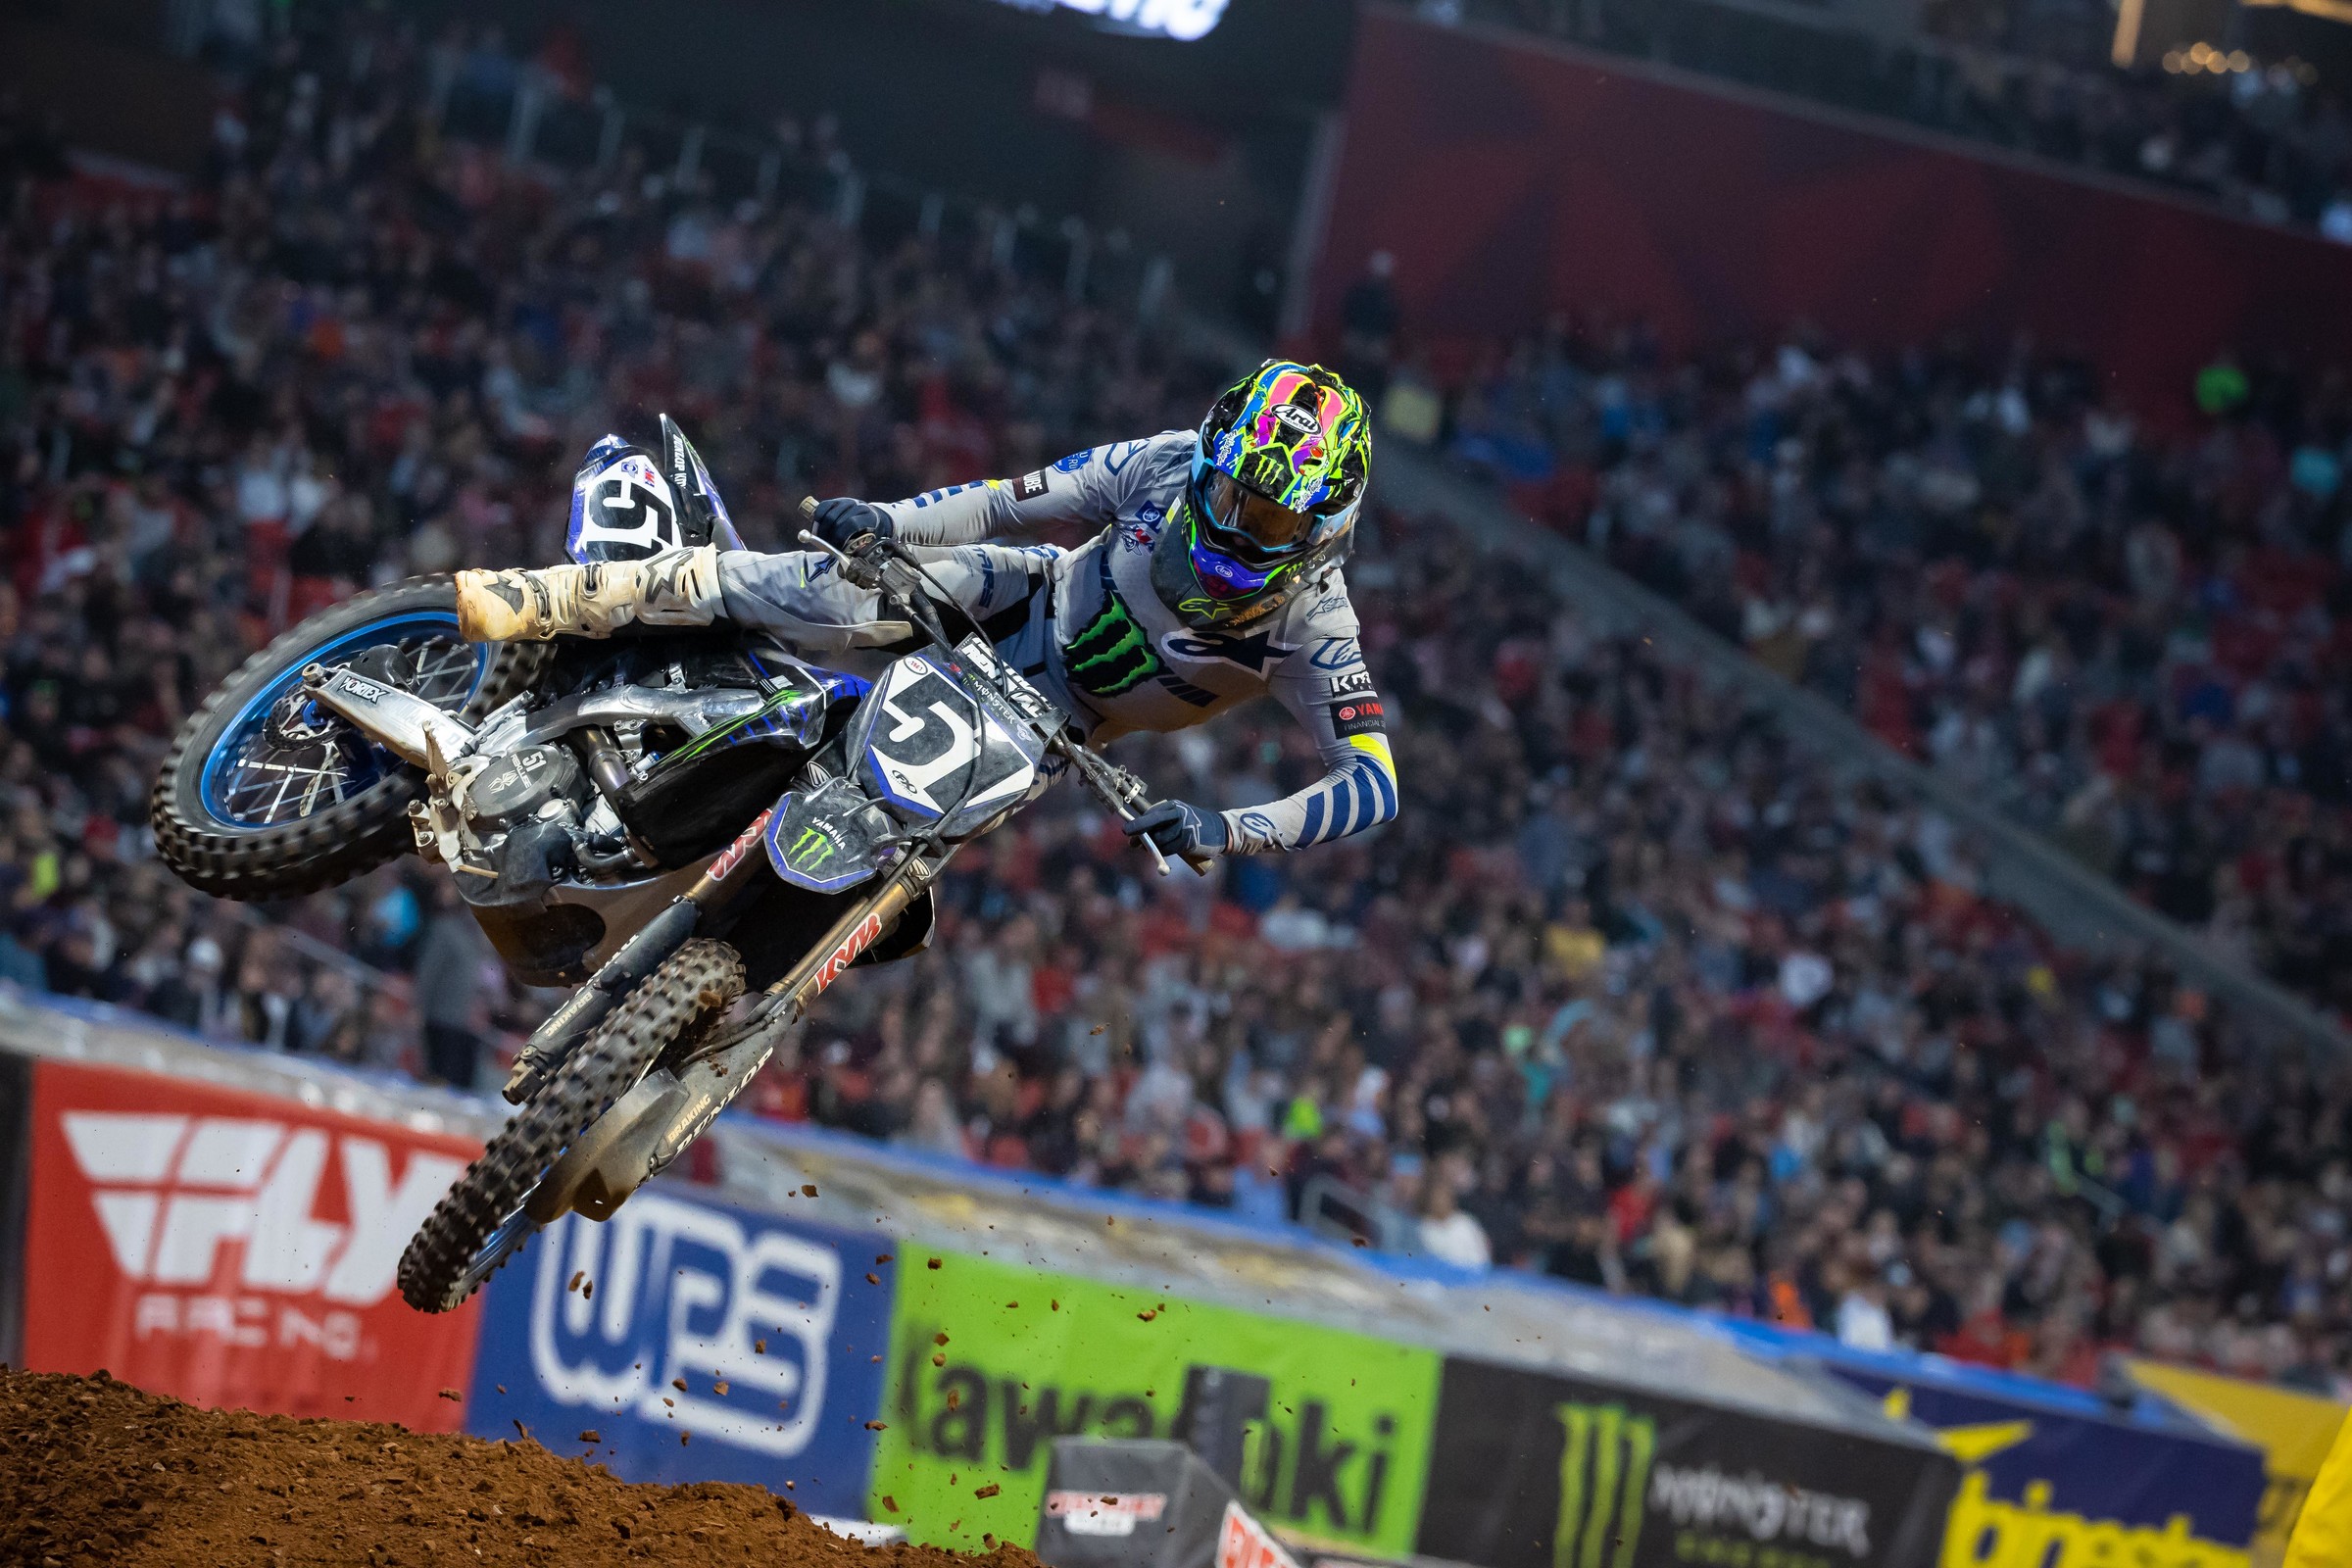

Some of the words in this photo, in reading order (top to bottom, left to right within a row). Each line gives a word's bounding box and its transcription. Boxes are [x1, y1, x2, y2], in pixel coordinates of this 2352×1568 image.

[1276, 407, 1317, 429] Arai
[673, 434, 686, 471] DUNLOP
[342, 676, 389, 704] VORTEX
[961, 643, 1040, 718] RENAL
[973, 679, 1015, 725] MONSTER
[1356, 703, 1384, 717] YAM
[522, 752, 547, 772] 51
[870, 672, 1029, 814] 51
[510, 753, 532, 789] REKLUSE
[811, 816, 847, 851] YAMAHA
[545, 991, 593, 1037] BRAKING
[667, 1094, 711, 1144] BRAKING
[60, 1109, 470, 1307] FLY
[135, 1292, 362, 1362] RACING
[895, 1321, 1398, 1539] awaki
